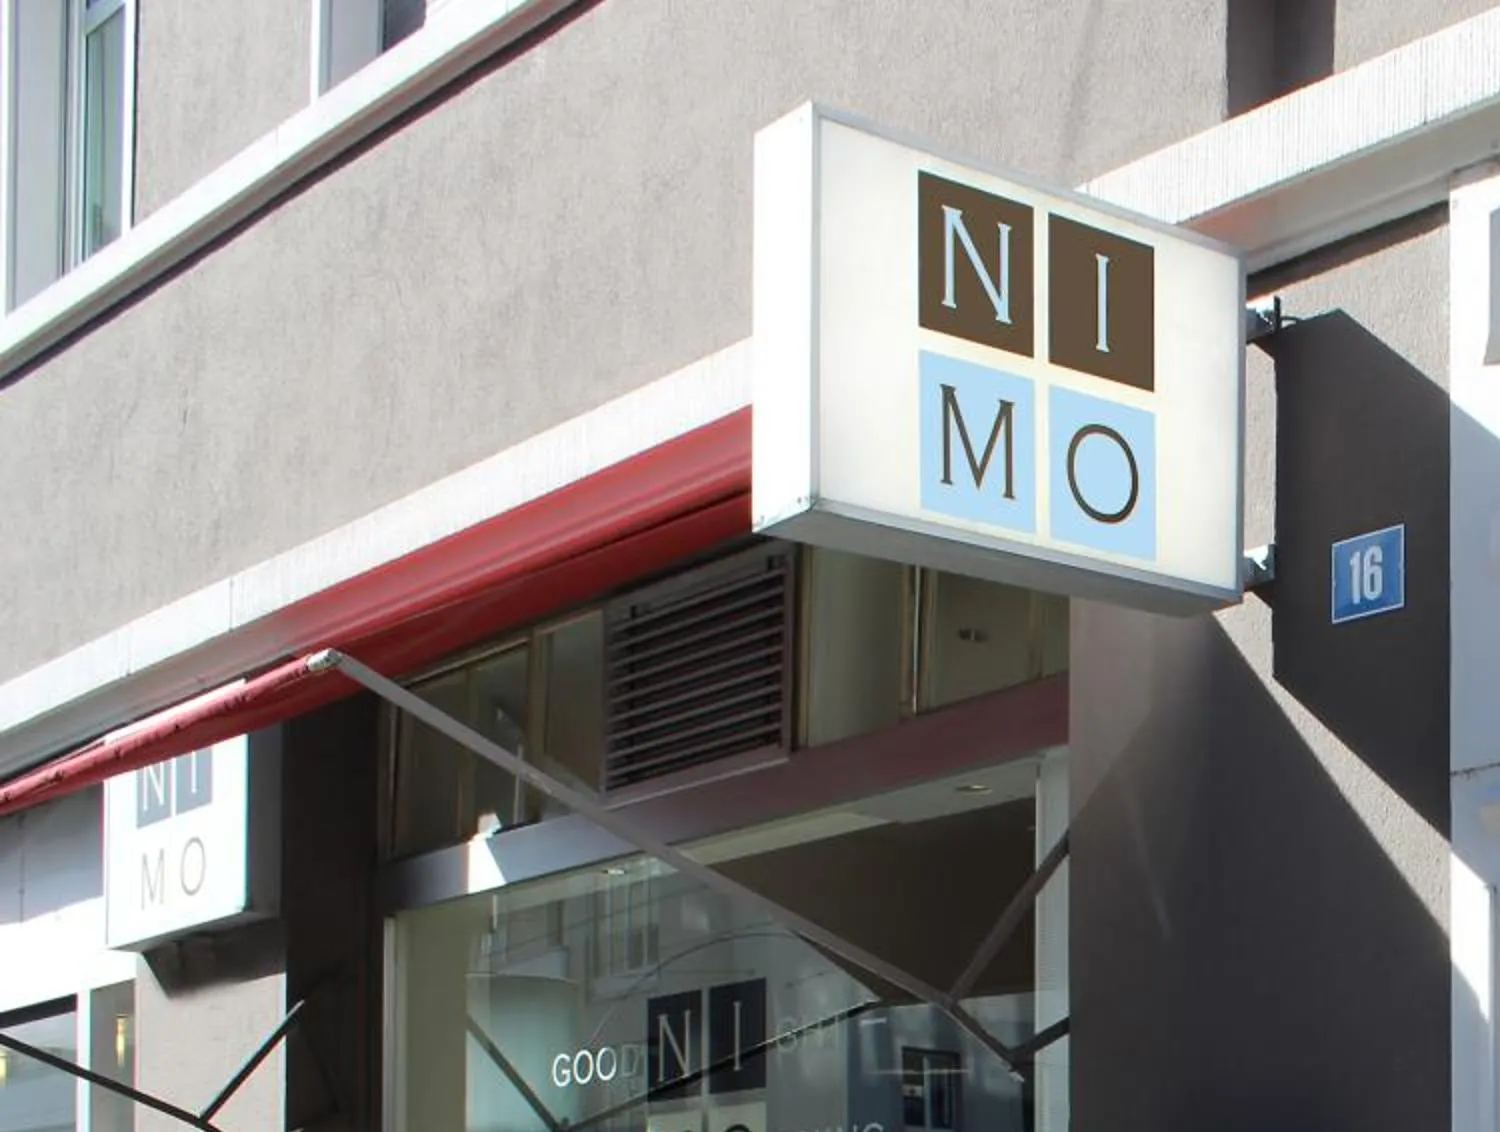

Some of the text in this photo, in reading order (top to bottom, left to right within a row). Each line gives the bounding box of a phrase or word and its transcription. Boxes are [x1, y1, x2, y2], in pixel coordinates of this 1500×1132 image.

[941, 204, 1110, 353] NI
[939, 384, 1140, 524] MO
[1350, 545, 1383, 605] 16
[142, 837, 207, 911] MO
[552, 1042, 642, 1088] GOOD
